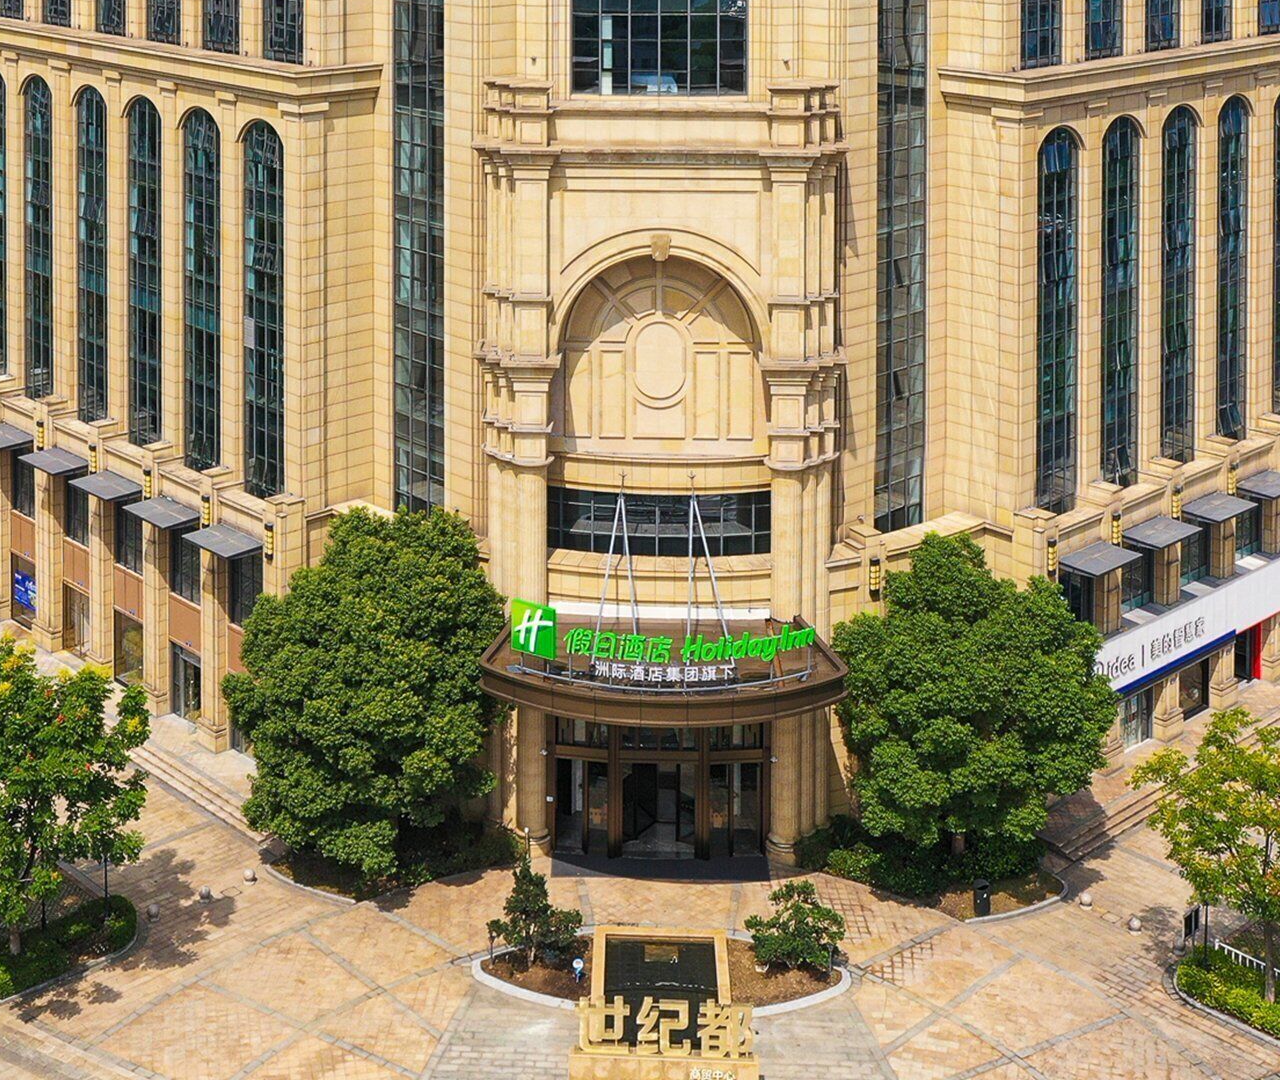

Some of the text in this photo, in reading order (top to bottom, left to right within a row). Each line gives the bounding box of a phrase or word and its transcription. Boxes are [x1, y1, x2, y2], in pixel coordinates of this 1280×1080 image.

[563, 624, 815, 664] 假日酒店 Holiday Inn
[595, 660, 734, 682] 洲际酒店集团旗下
[578, 996, 753, 1059] 世纪都
